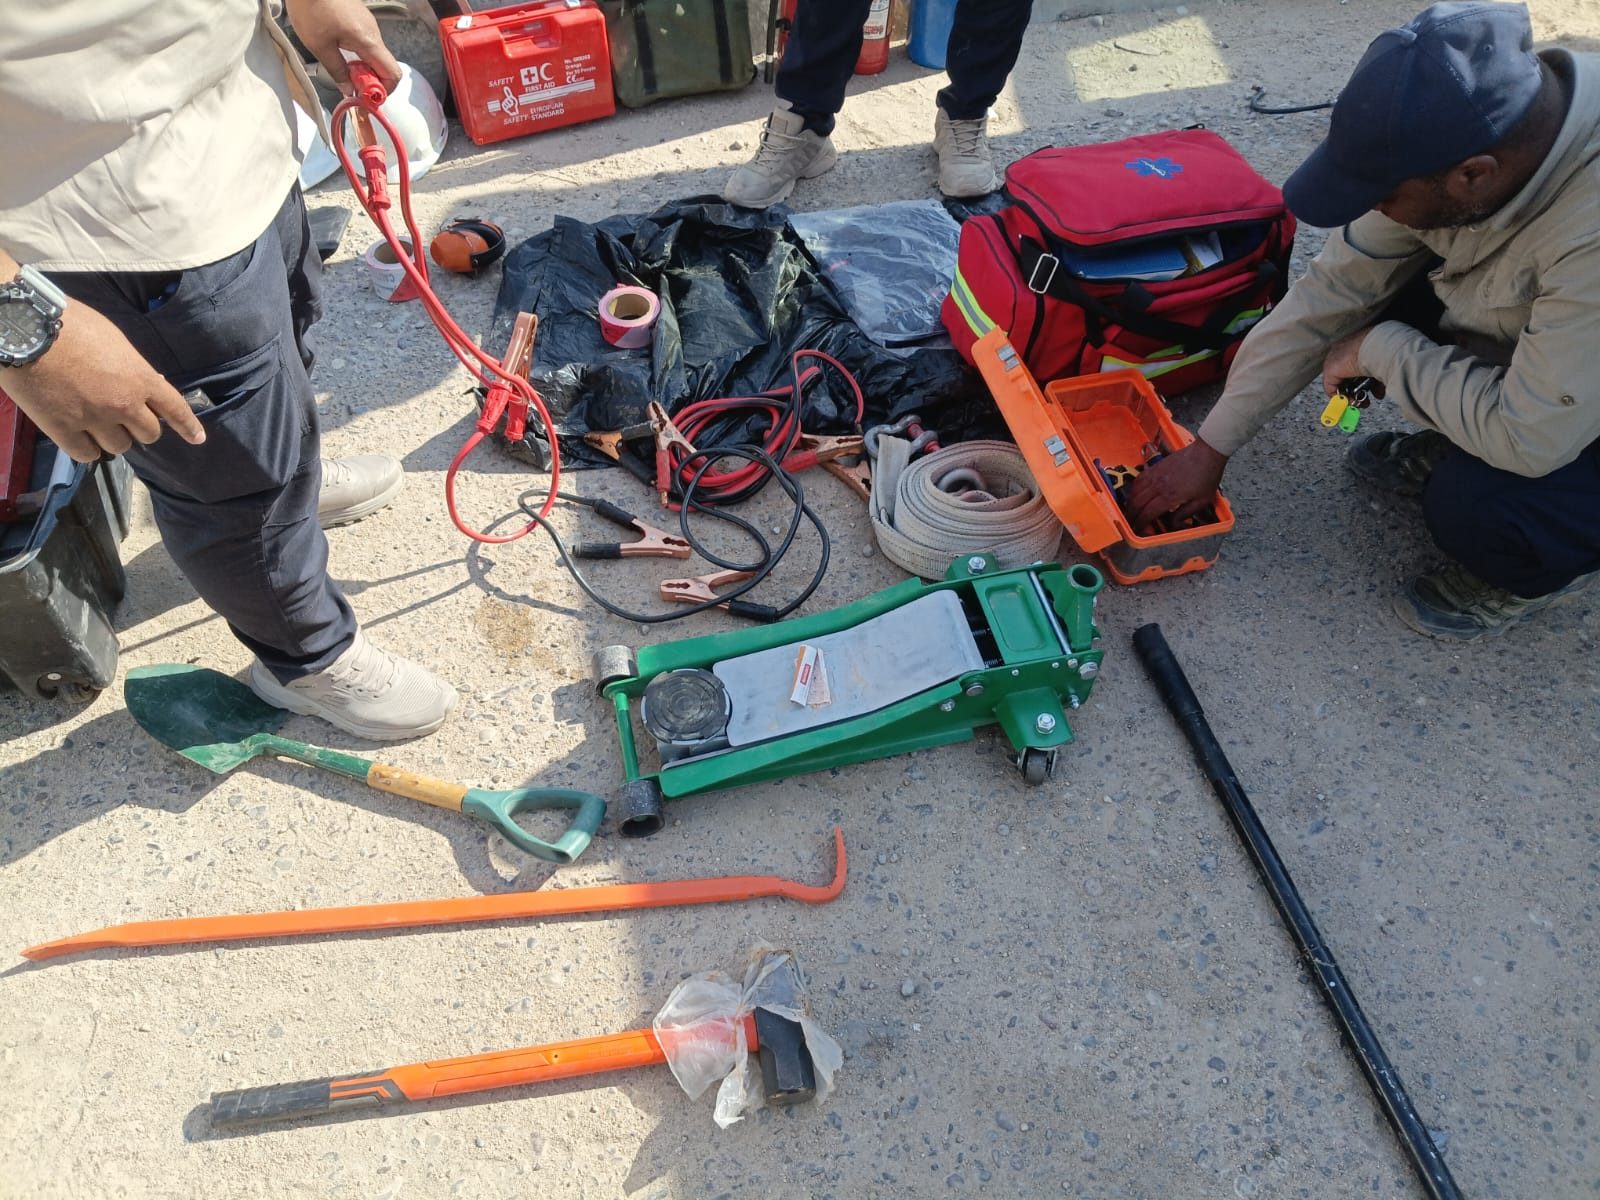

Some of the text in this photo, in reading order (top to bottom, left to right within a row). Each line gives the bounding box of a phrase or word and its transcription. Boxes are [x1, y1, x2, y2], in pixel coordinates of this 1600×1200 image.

[488, 76, 515, 88] SAFETY
[525, 81, 556, 93] FIRST AID
[503, 114, 529, 125] SAFETY
[531, 108, 565, 121] STANDARD
